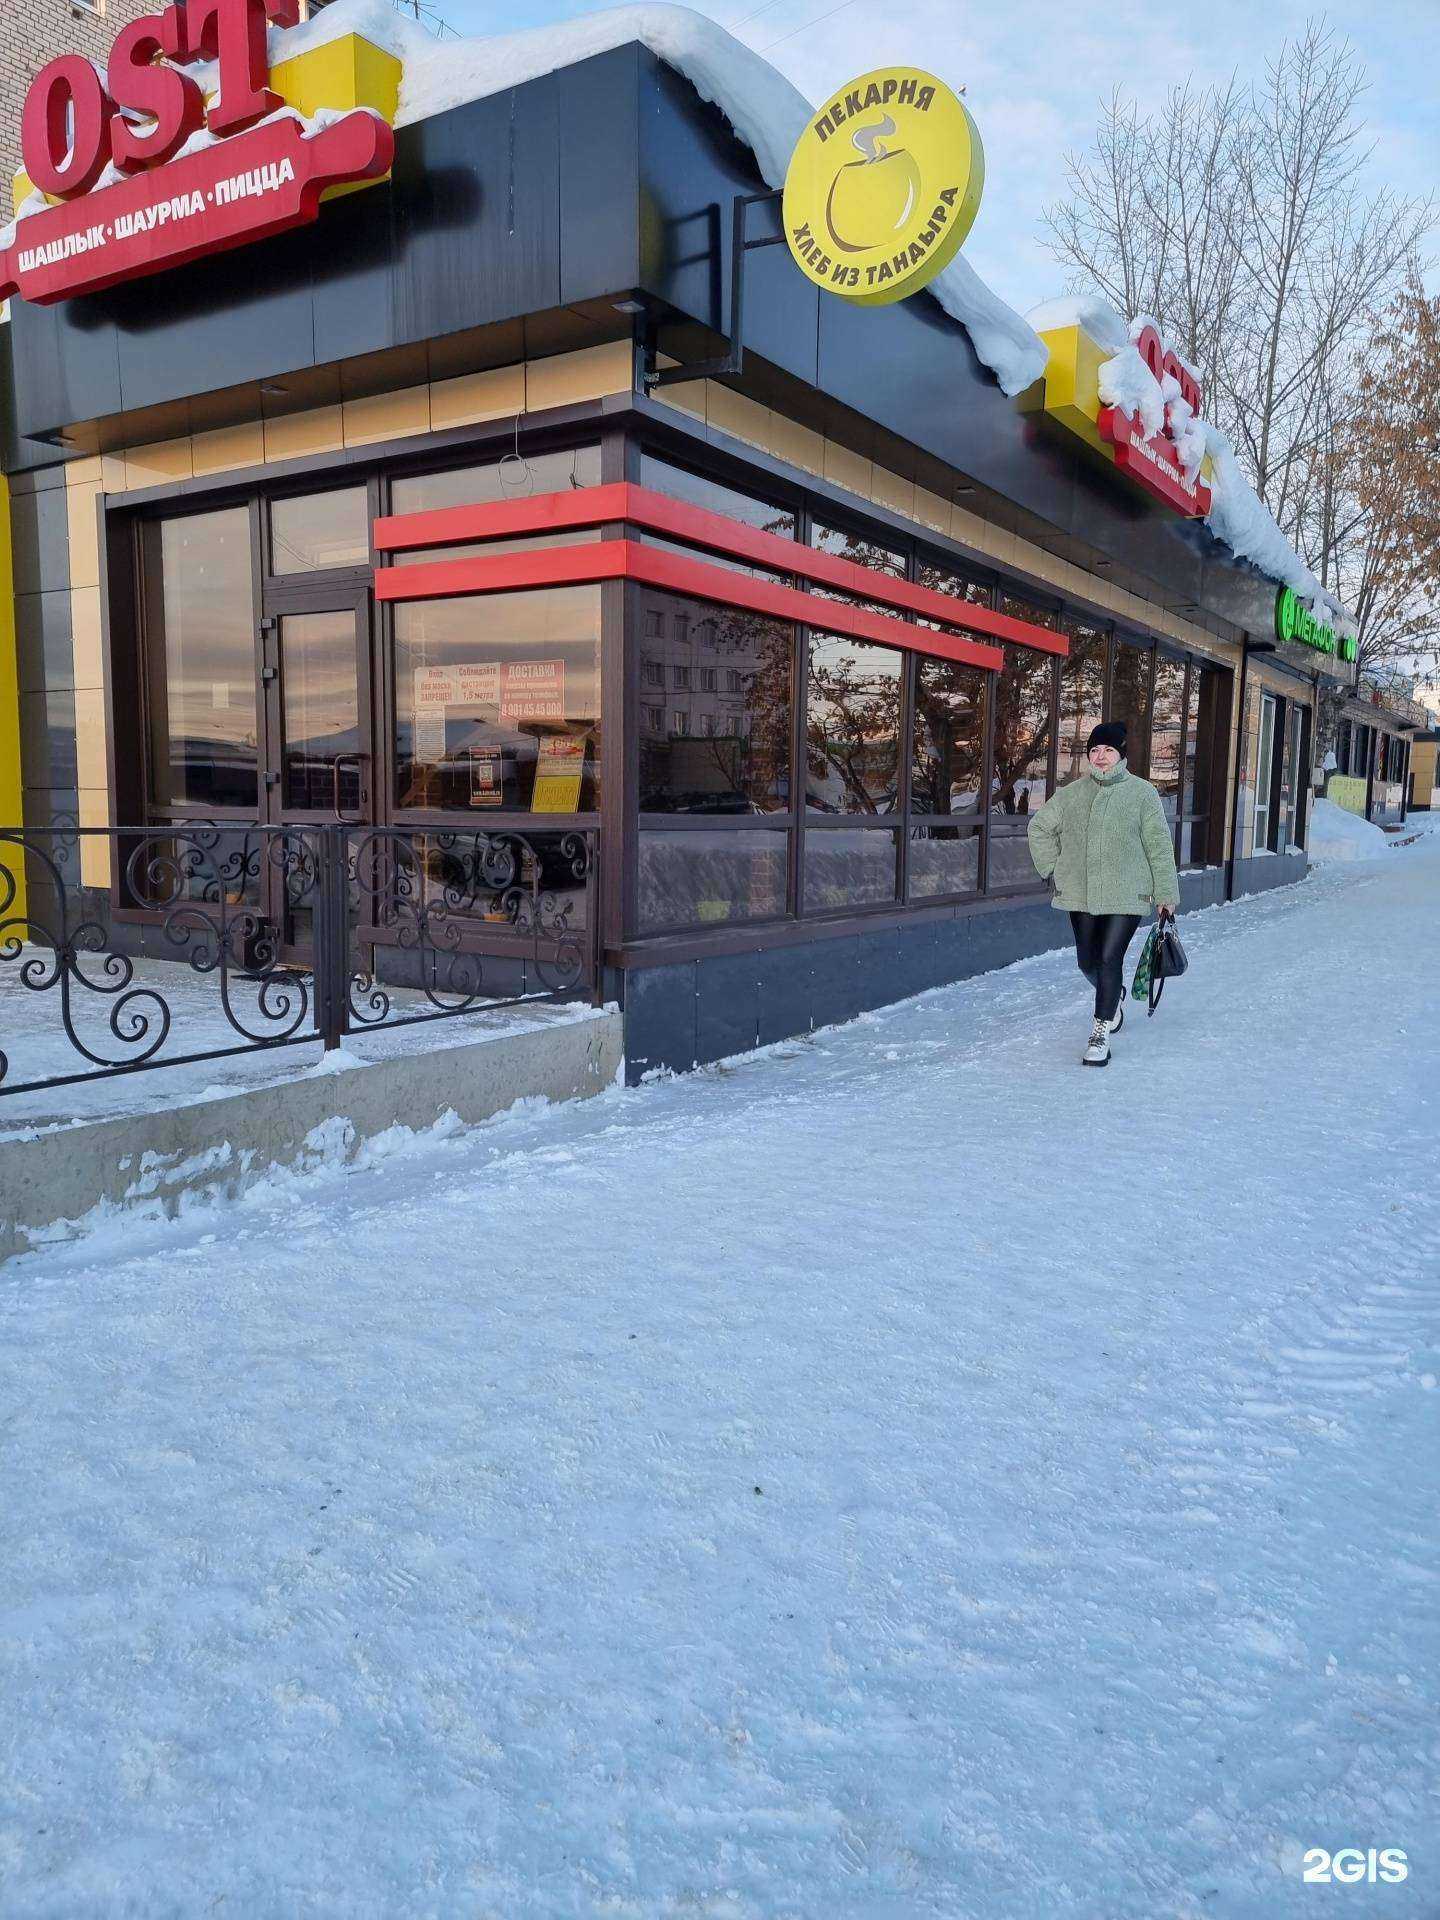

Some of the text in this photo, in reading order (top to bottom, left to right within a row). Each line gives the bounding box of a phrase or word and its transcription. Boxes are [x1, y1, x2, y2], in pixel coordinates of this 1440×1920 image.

[814, 79, 935, 142] ПЕКАРНЯ
[18, 157, 294, 273] ШАШЛЫК ШАУРМА ПИЦЦА
[793, 186, 959, 286] ХЛЕБ ИЗ ТАНДЫРА
[508, 664, 555, 680] ДОСТАВКА
